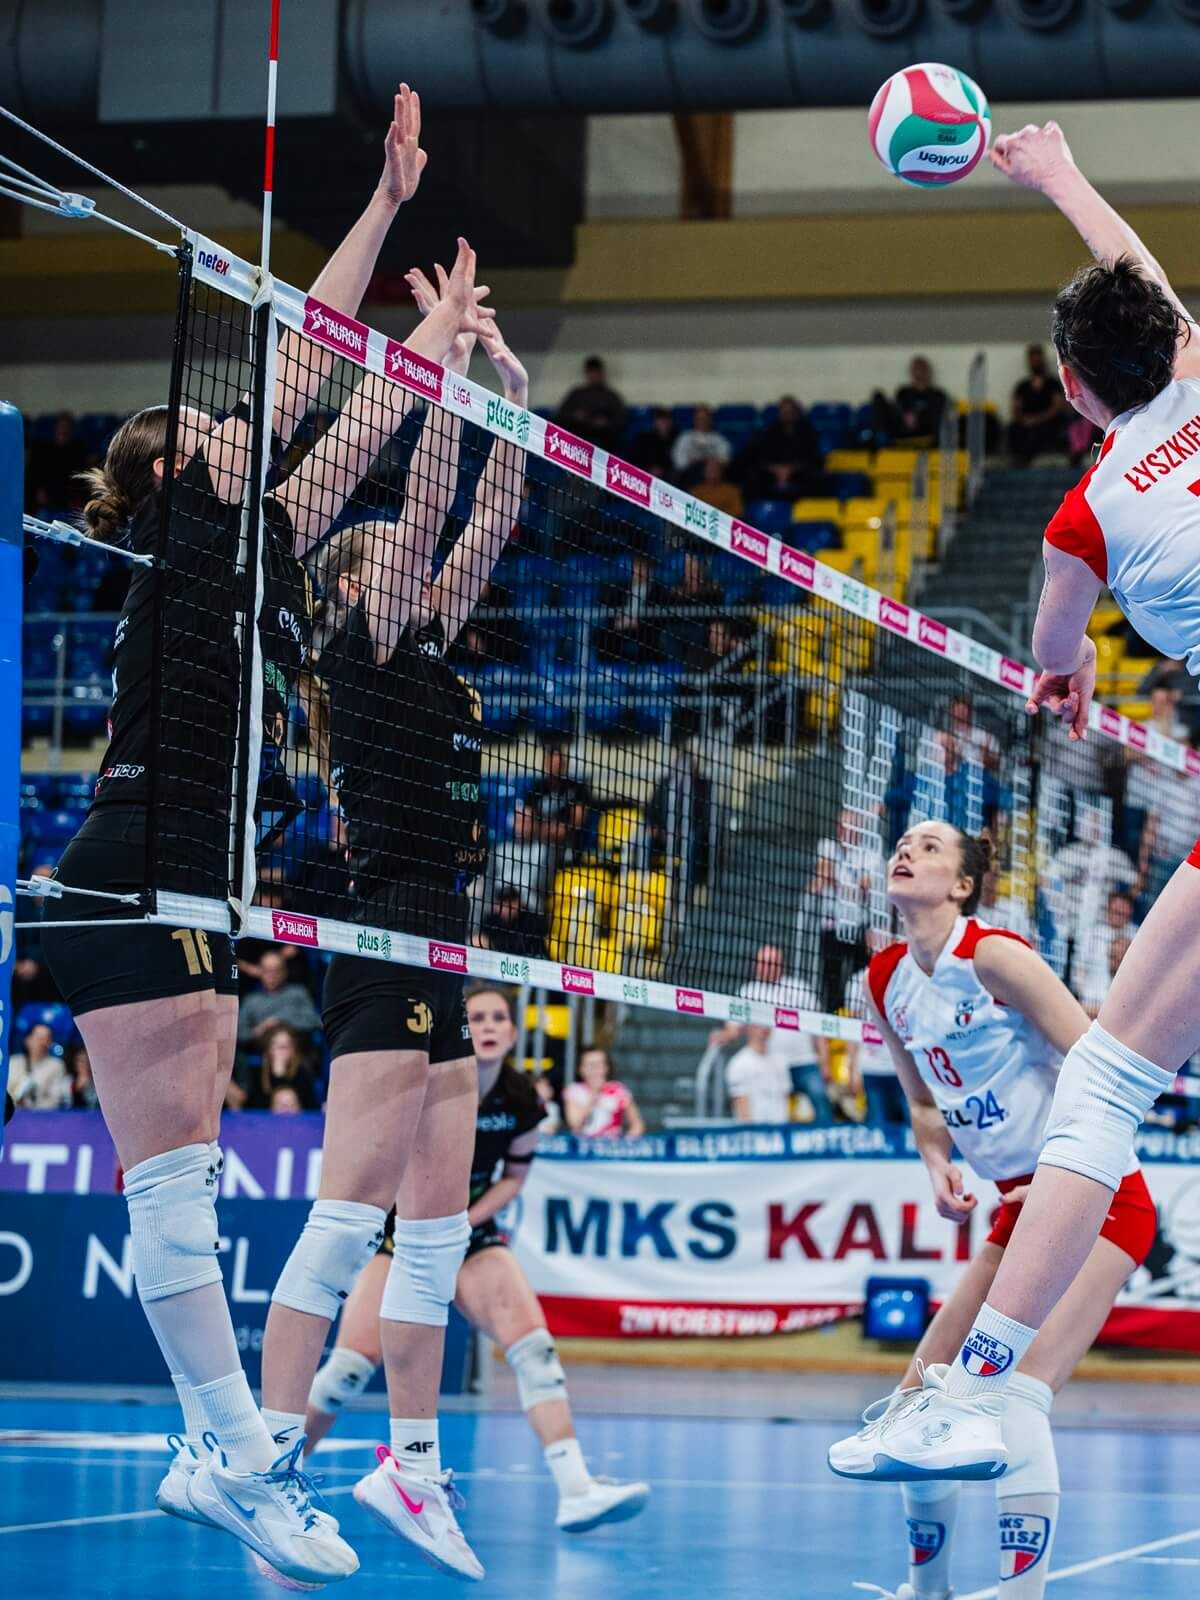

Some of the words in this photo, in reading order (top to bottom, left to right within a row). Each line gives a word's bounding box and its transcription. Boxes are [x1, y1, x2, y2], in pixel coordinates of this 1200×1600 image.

[919, 151, 969, 166] molten
[198, 250, 230, 277] netex
[325, 317, 363, 352] TAURON
[402, 357, 439, 391] TAURON
[452, 384, 473, 409] LIGA
[486, 397, 515, 433] plus
[559, 437, 590, 468] TAURON
[684, 500, 708, 529] plus
[286, 920, 314, 939] TAURON
[357, 929, 379, 953] plus
[440, 952, 465, 967] TAURON
[500, 957, 520, 980] plus
[544, 1196, 739, 1262] MKS
[767, 1203, 1002, 1264] KALI
[966, 1336, 1007, 1364] KALISZ
[975, 1332, 998, 1350] MKS
[404, 1440, 436, 1453] 4F
[1000, 1530, 1042, 1546] LISZ
